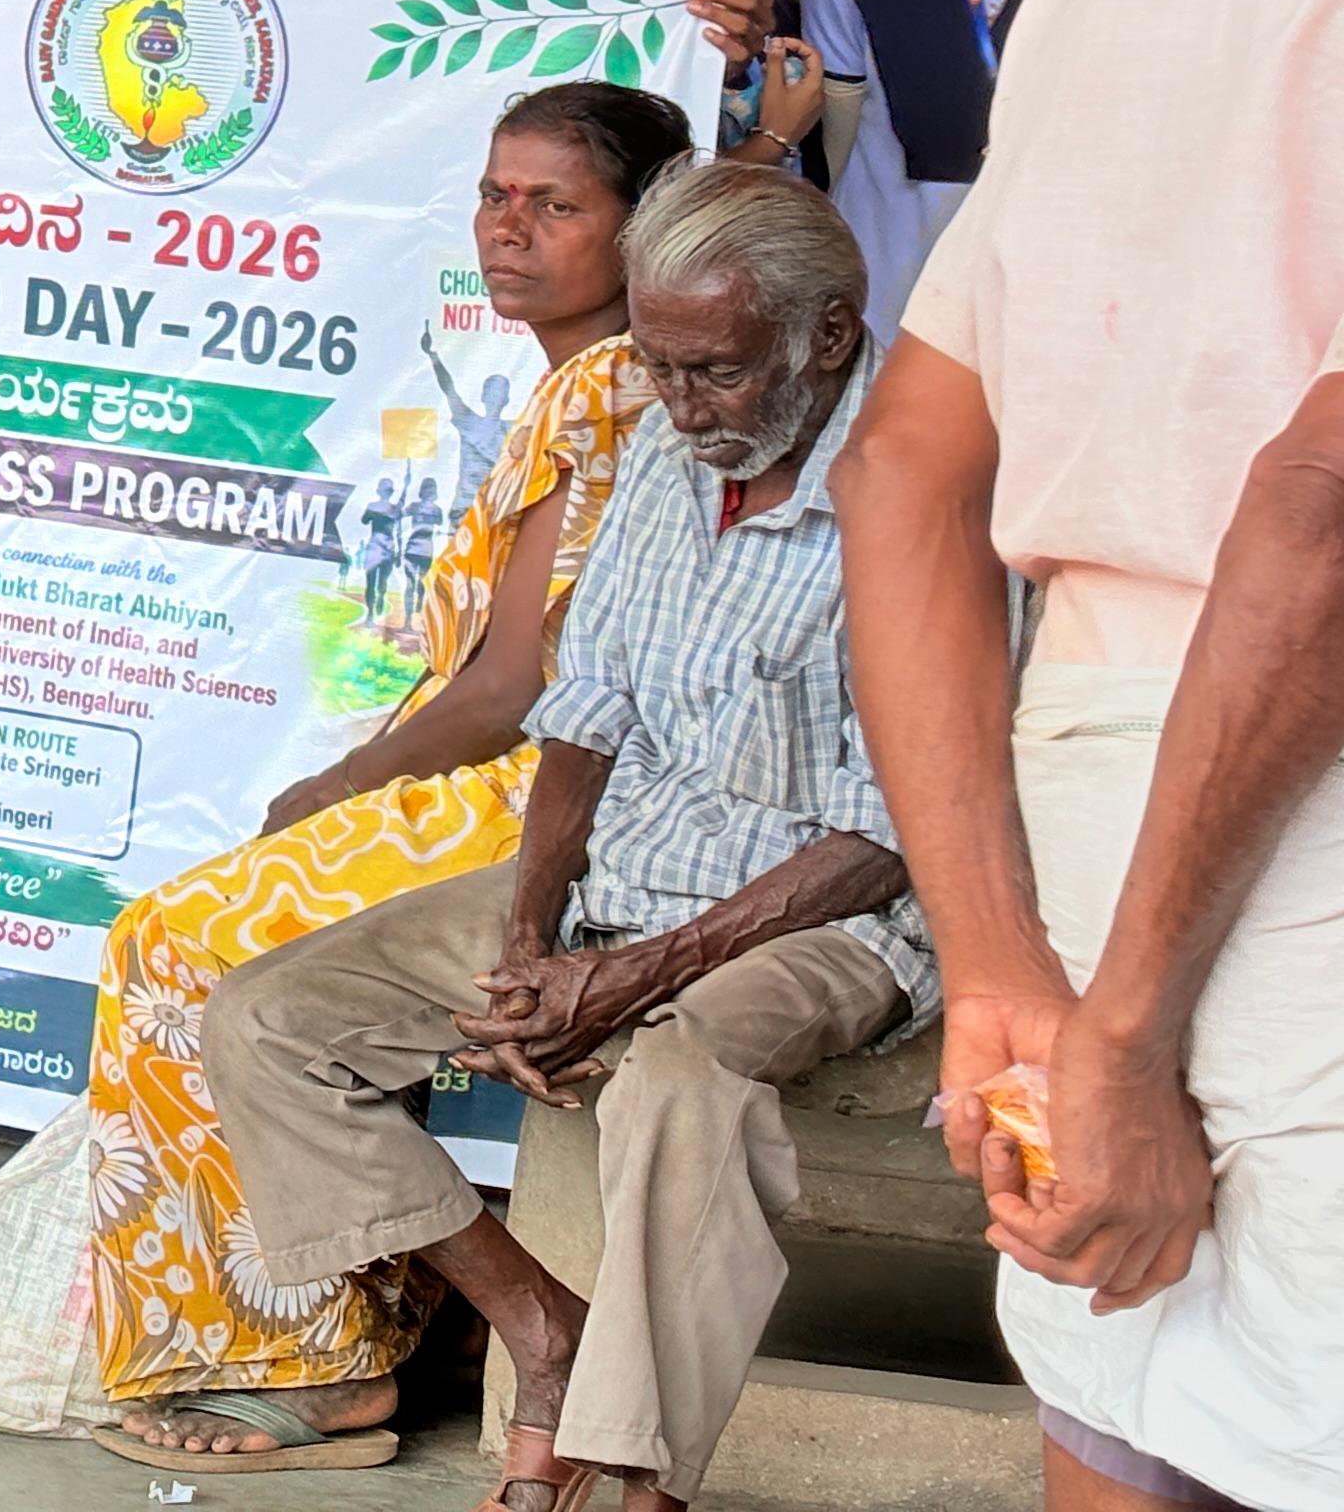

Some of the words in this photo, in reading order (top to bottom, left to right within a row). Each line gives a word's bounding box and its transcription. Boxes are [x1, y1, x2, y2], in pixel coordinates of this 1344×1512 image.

[153, 209, 323, 282] 2026
[443, 303, 485, 331] NOT
[70, 468, 329, 546] PROGRAM
[1, 543, 96, 575] connection
[100, 553, 141, 581] with
[144, 557, 177, 586] the
[45, 577, 124, 615] Bharat
[130, 591, 236, 636] Abhiyan,
[61, 614, 85, 641] of
[89, 618, 151, 655] India,
[156, 632, 199, 659] and
[42, 675, 155, 721] Bengaluru.
[80, 651, 104, 677] of
[107, 656, 177, 691] Health
[182, 669, 279, 707] Sciences
[13, 724, 78, 756] ROUTE
[23, 755, 102, 790] Sringeri
